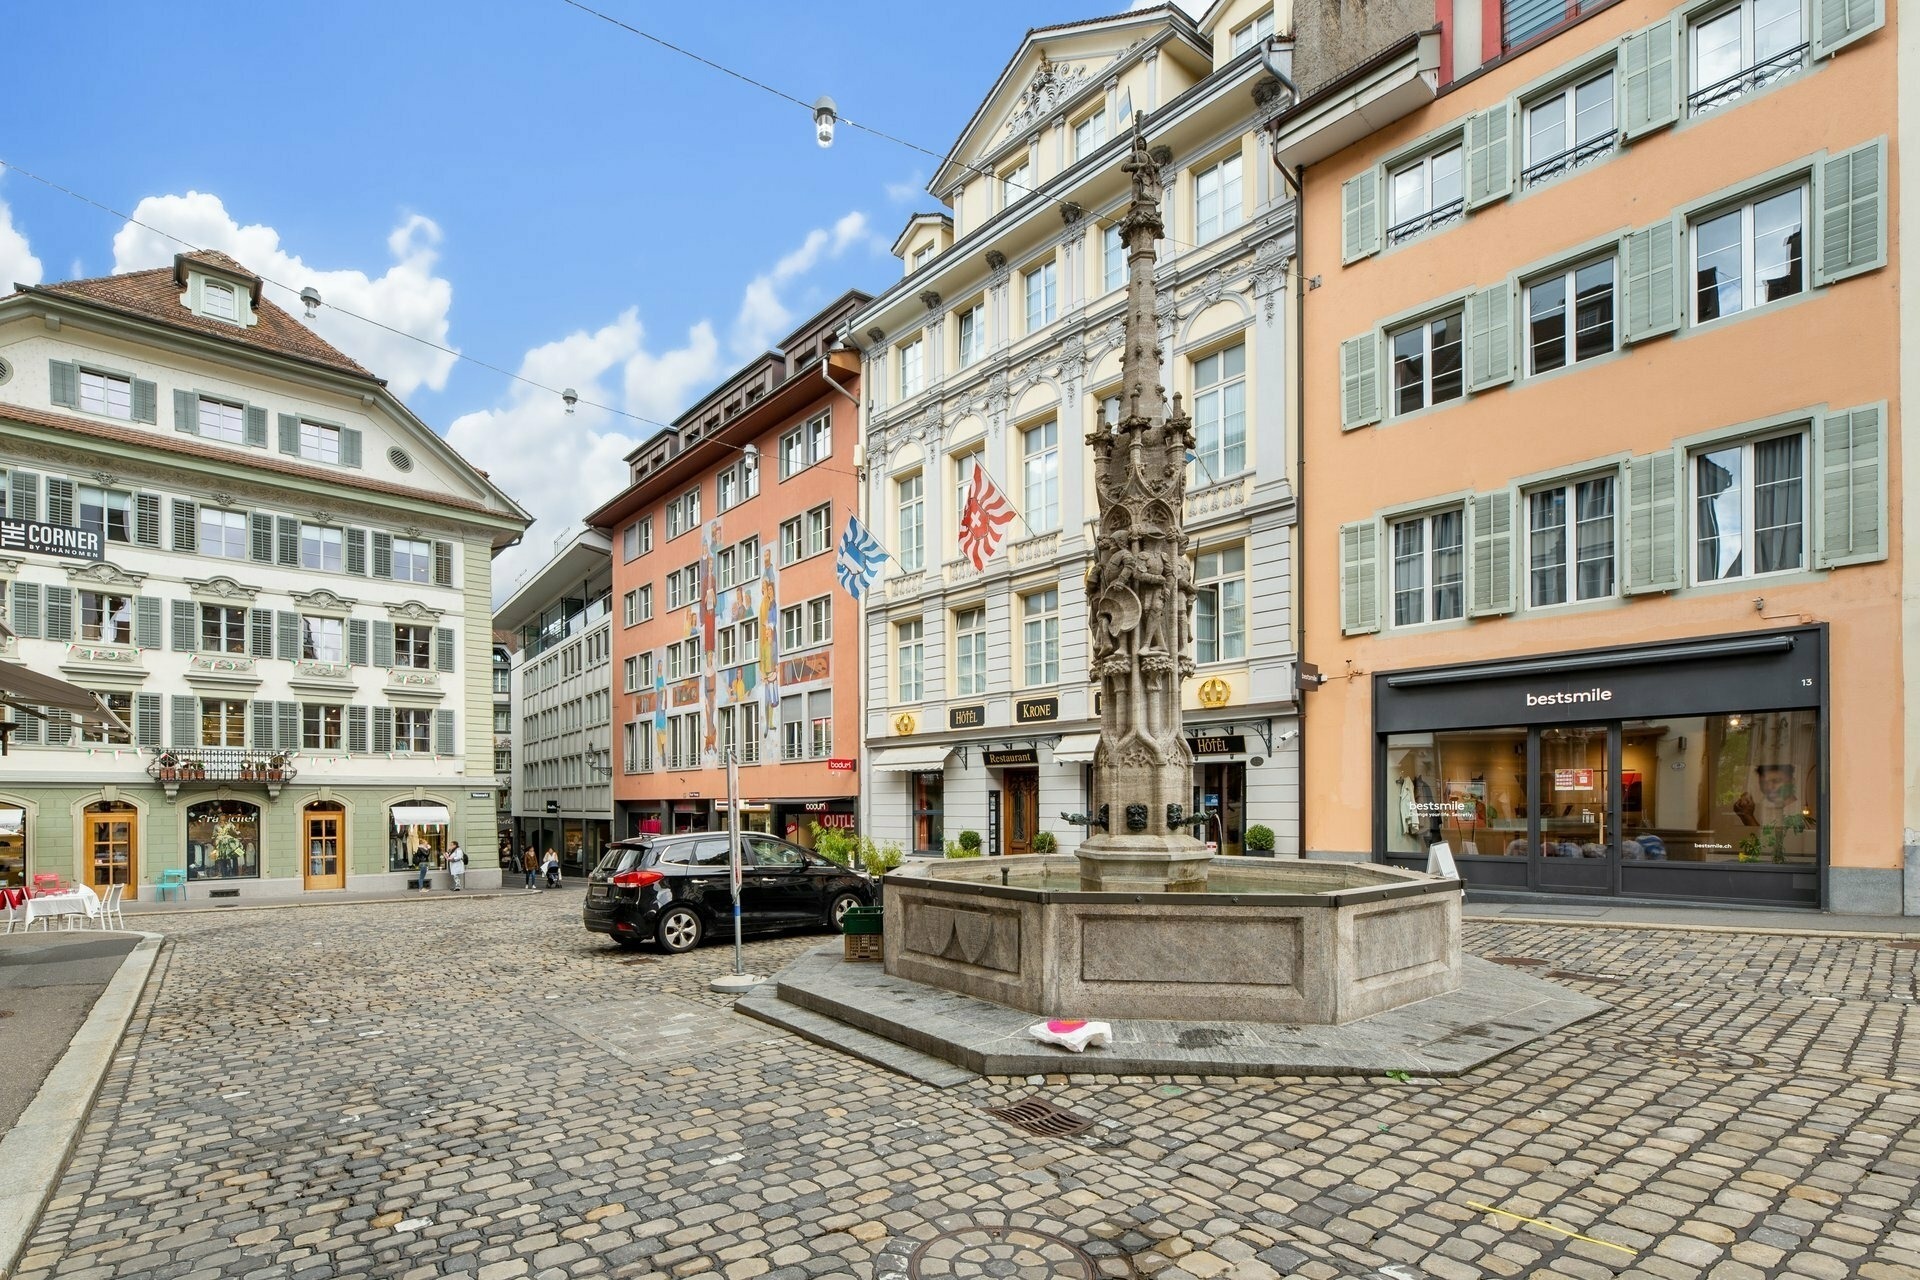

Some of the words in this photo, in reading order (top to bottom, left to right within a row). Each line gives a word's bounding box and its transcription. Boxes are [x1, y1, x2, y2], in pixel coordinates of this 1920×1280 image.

[1, 521, 25, 547] THE
[28, 524, 98, 550] CORNER
[45, 546, 98, 558] PHÄNOMEN
[1801, 679, 1812, 687] 13
[1526, 688, 1612, 706] bestsmile
[1023, 703, 1051, 718] KRONE
[989, 753, 1031, 764] Restaurant
[830, 761, 852, 769] bodum
[1410, 801, 1465, 811] bestsmile
[824, 814, 855, 828] OUTLE
